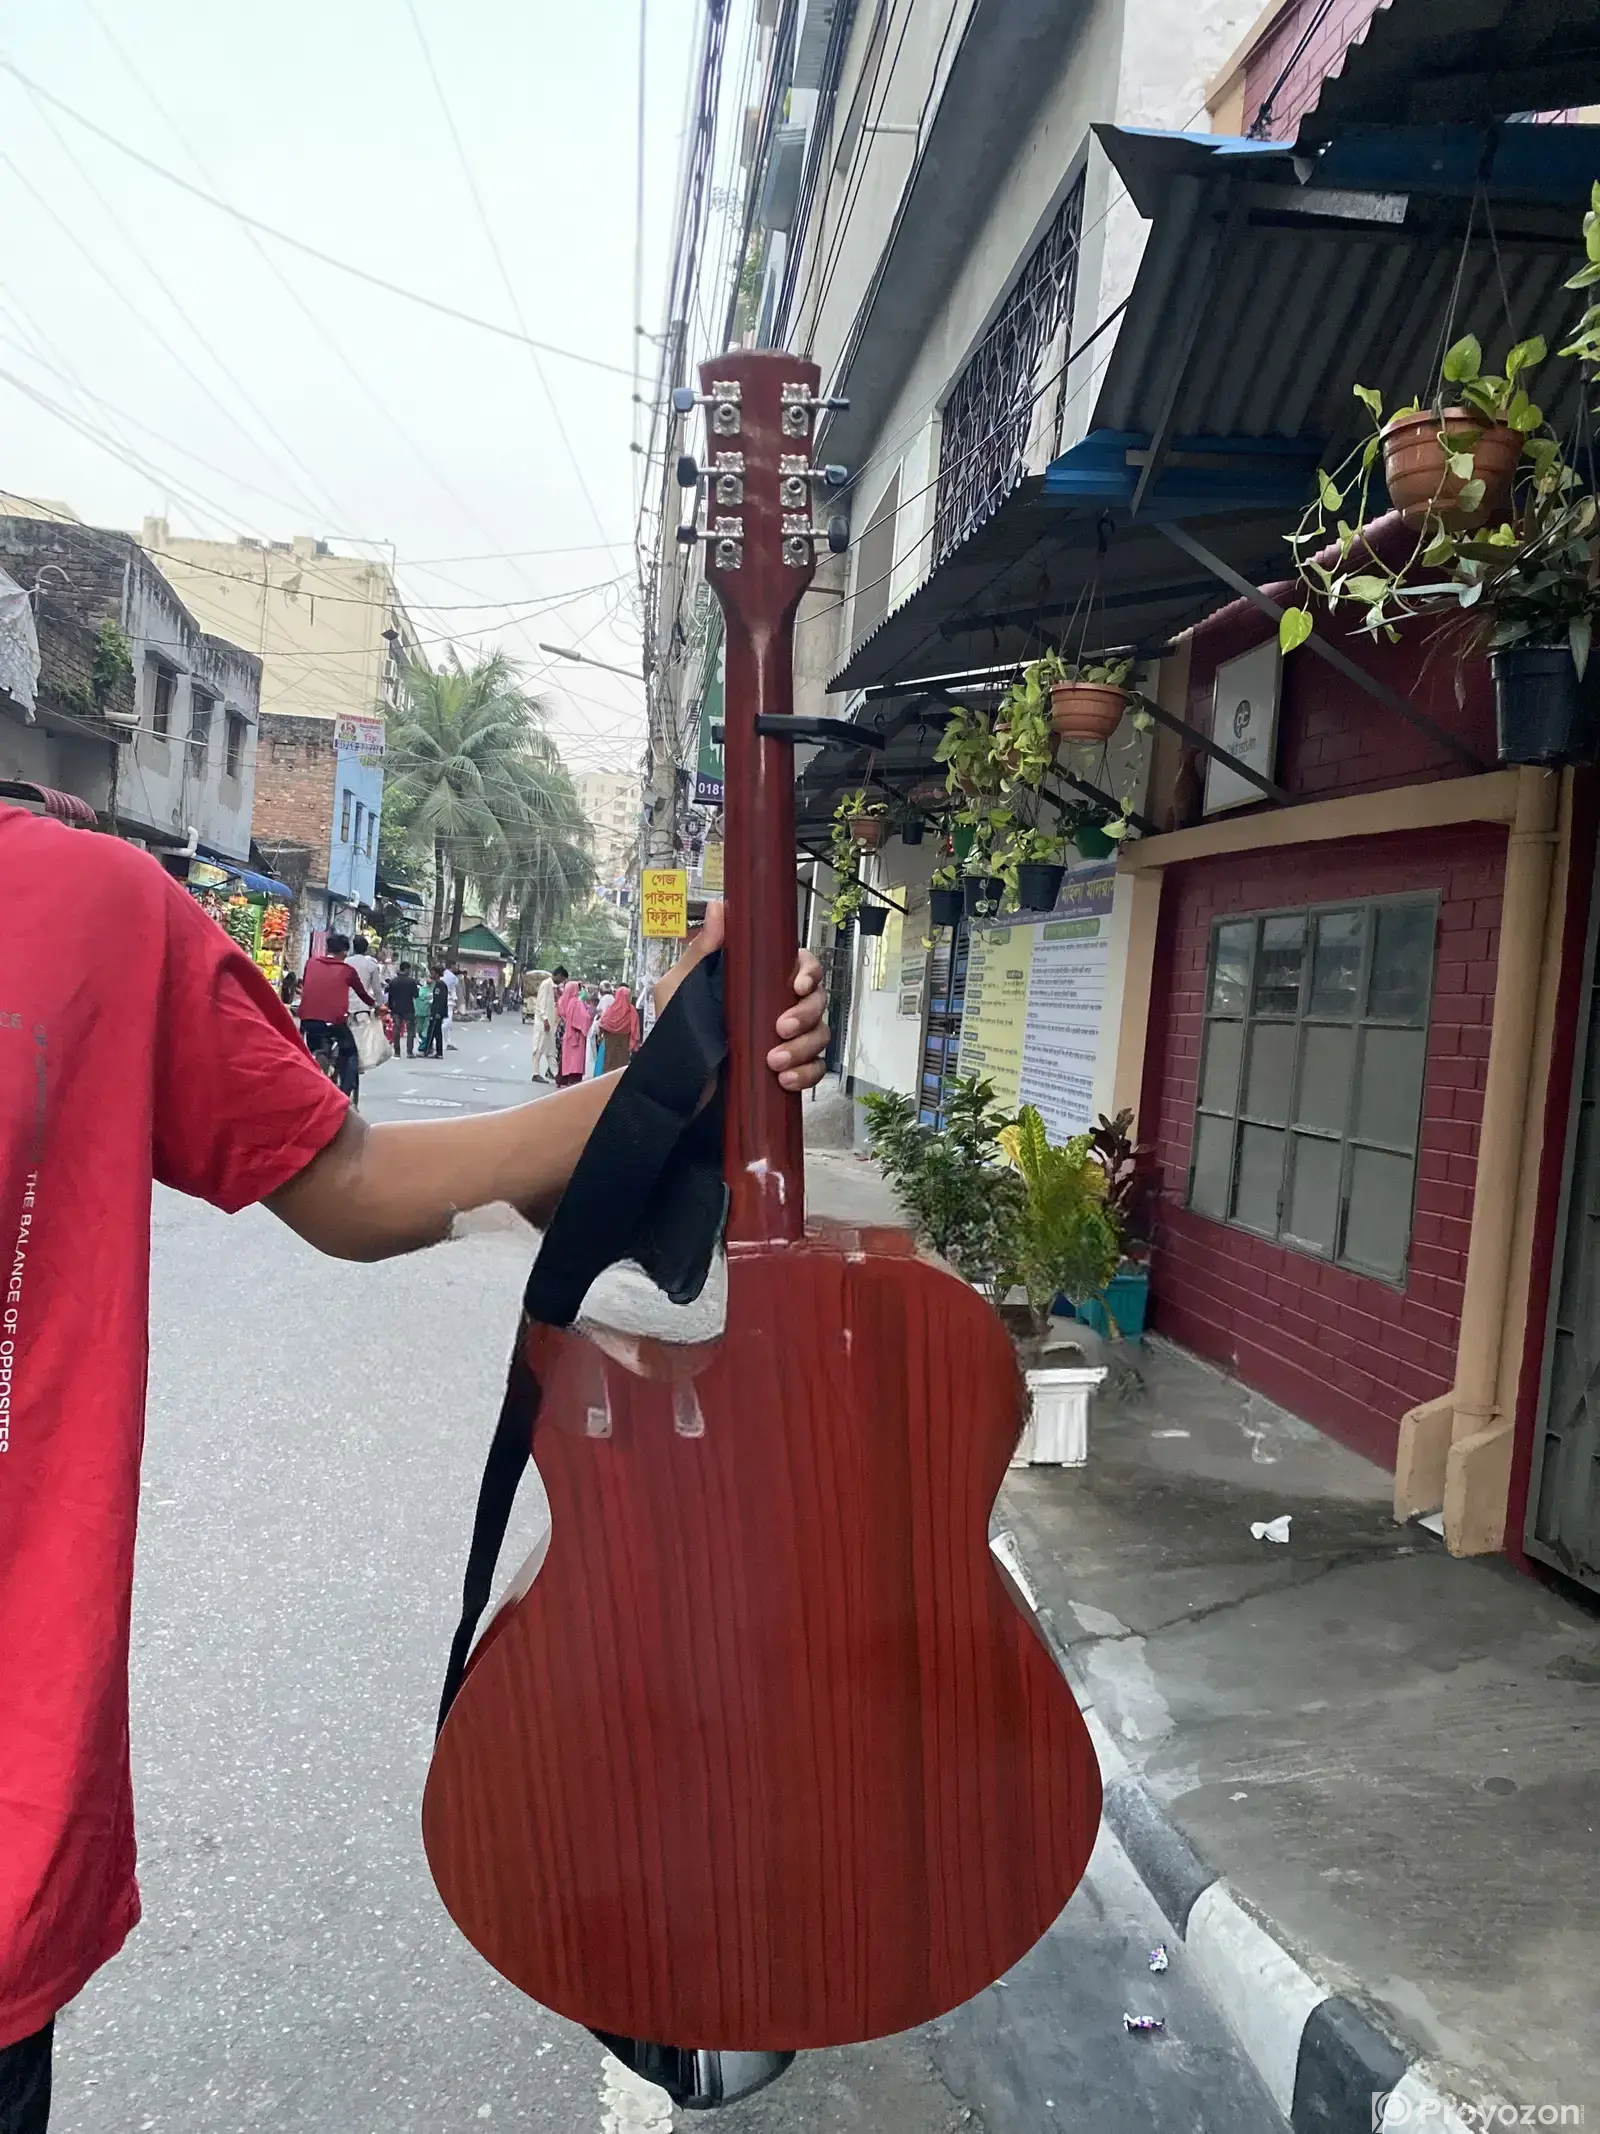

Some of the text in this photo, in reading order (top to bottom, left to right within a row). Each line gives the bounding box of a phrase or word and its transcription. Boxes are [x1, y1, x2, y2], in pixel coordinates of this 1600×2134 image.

[652, 874, 676, 886] গেজ
[644, 888, 684, 908] পাইলস্
[646, 907, 682, 928] ফিষ্টুলা
[0, 1170, 38, 1453] THE BALANCE OF OPPOSITES
